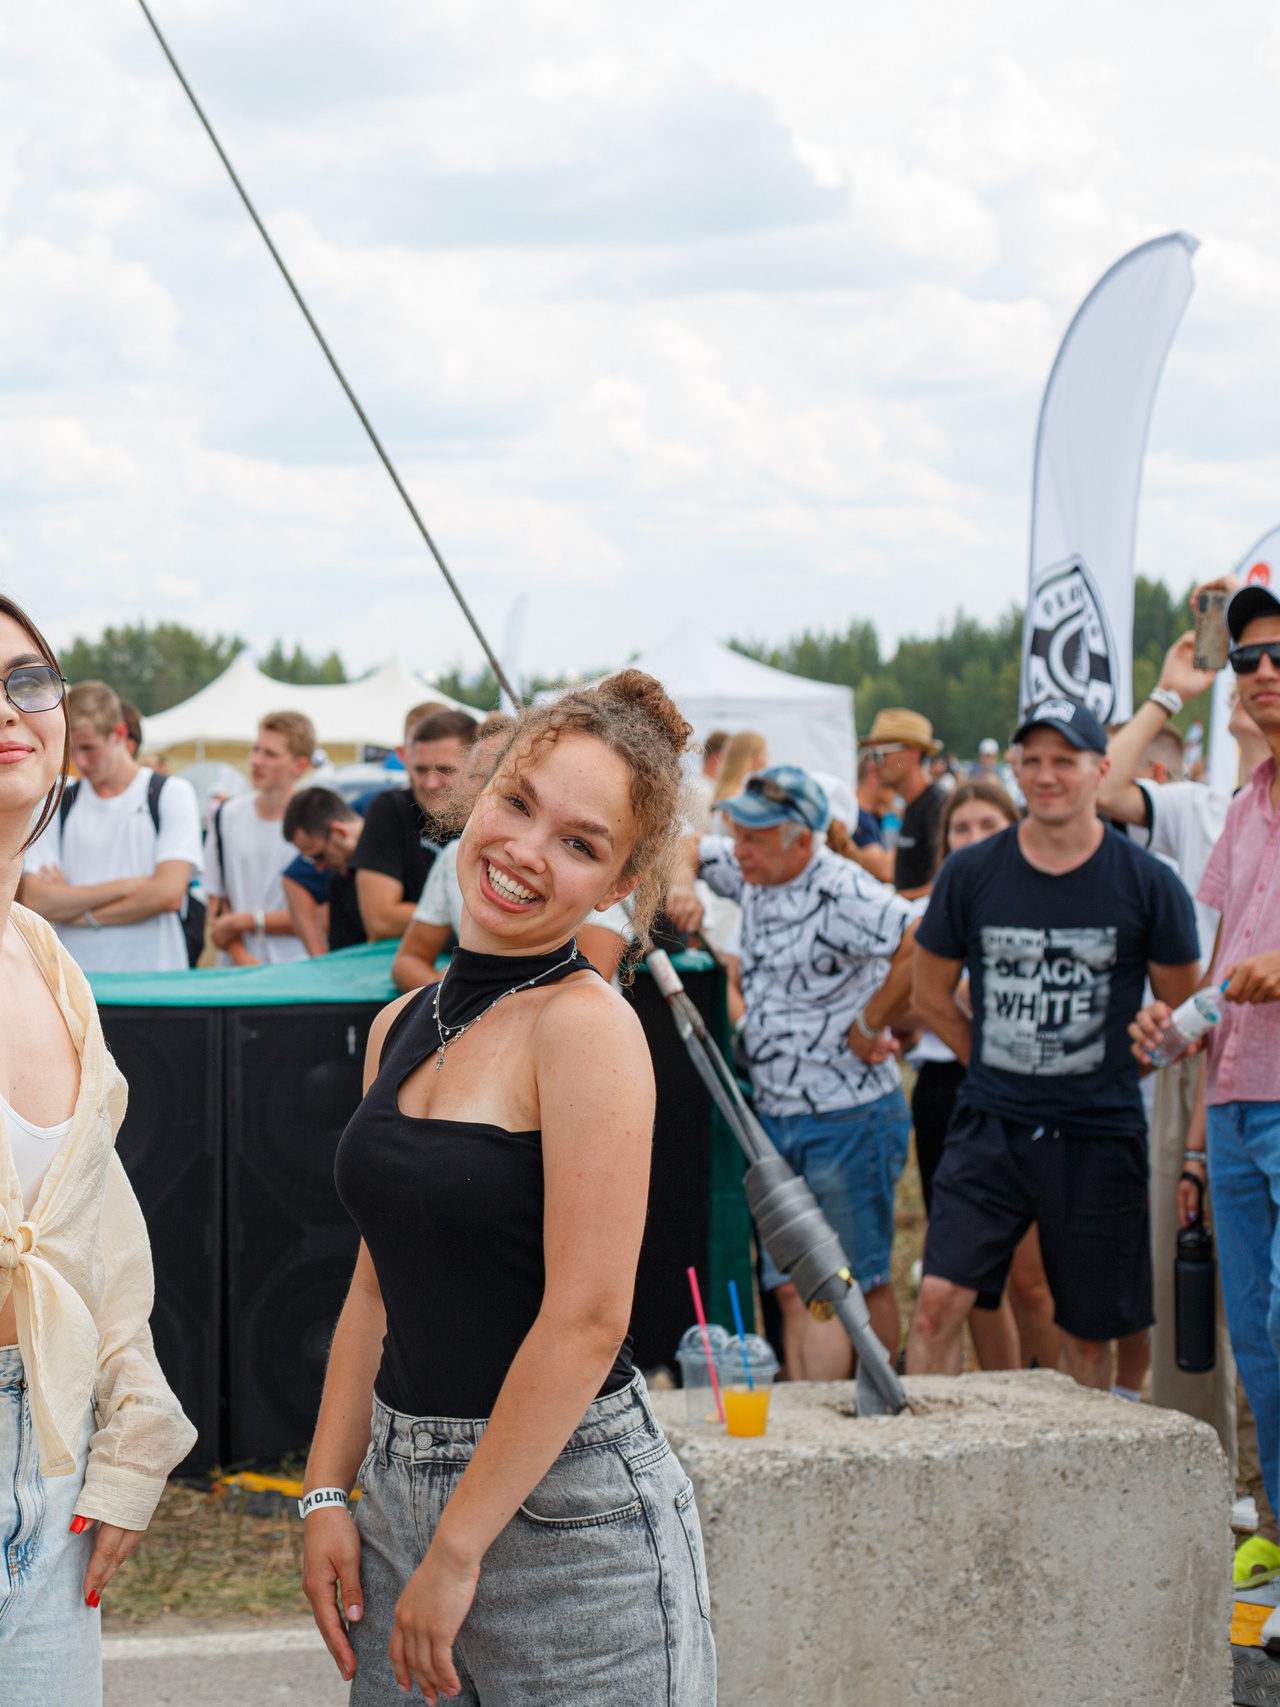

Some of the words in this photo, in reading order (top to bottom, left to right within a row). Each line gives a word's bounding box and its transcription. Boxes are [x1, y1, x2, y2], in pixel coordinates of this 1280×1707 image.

[994, 957, 1094, 985] BLACK
[994, 990, 1093, 1024] WHITE
[314, 1491, 347, 1503] AUTO
